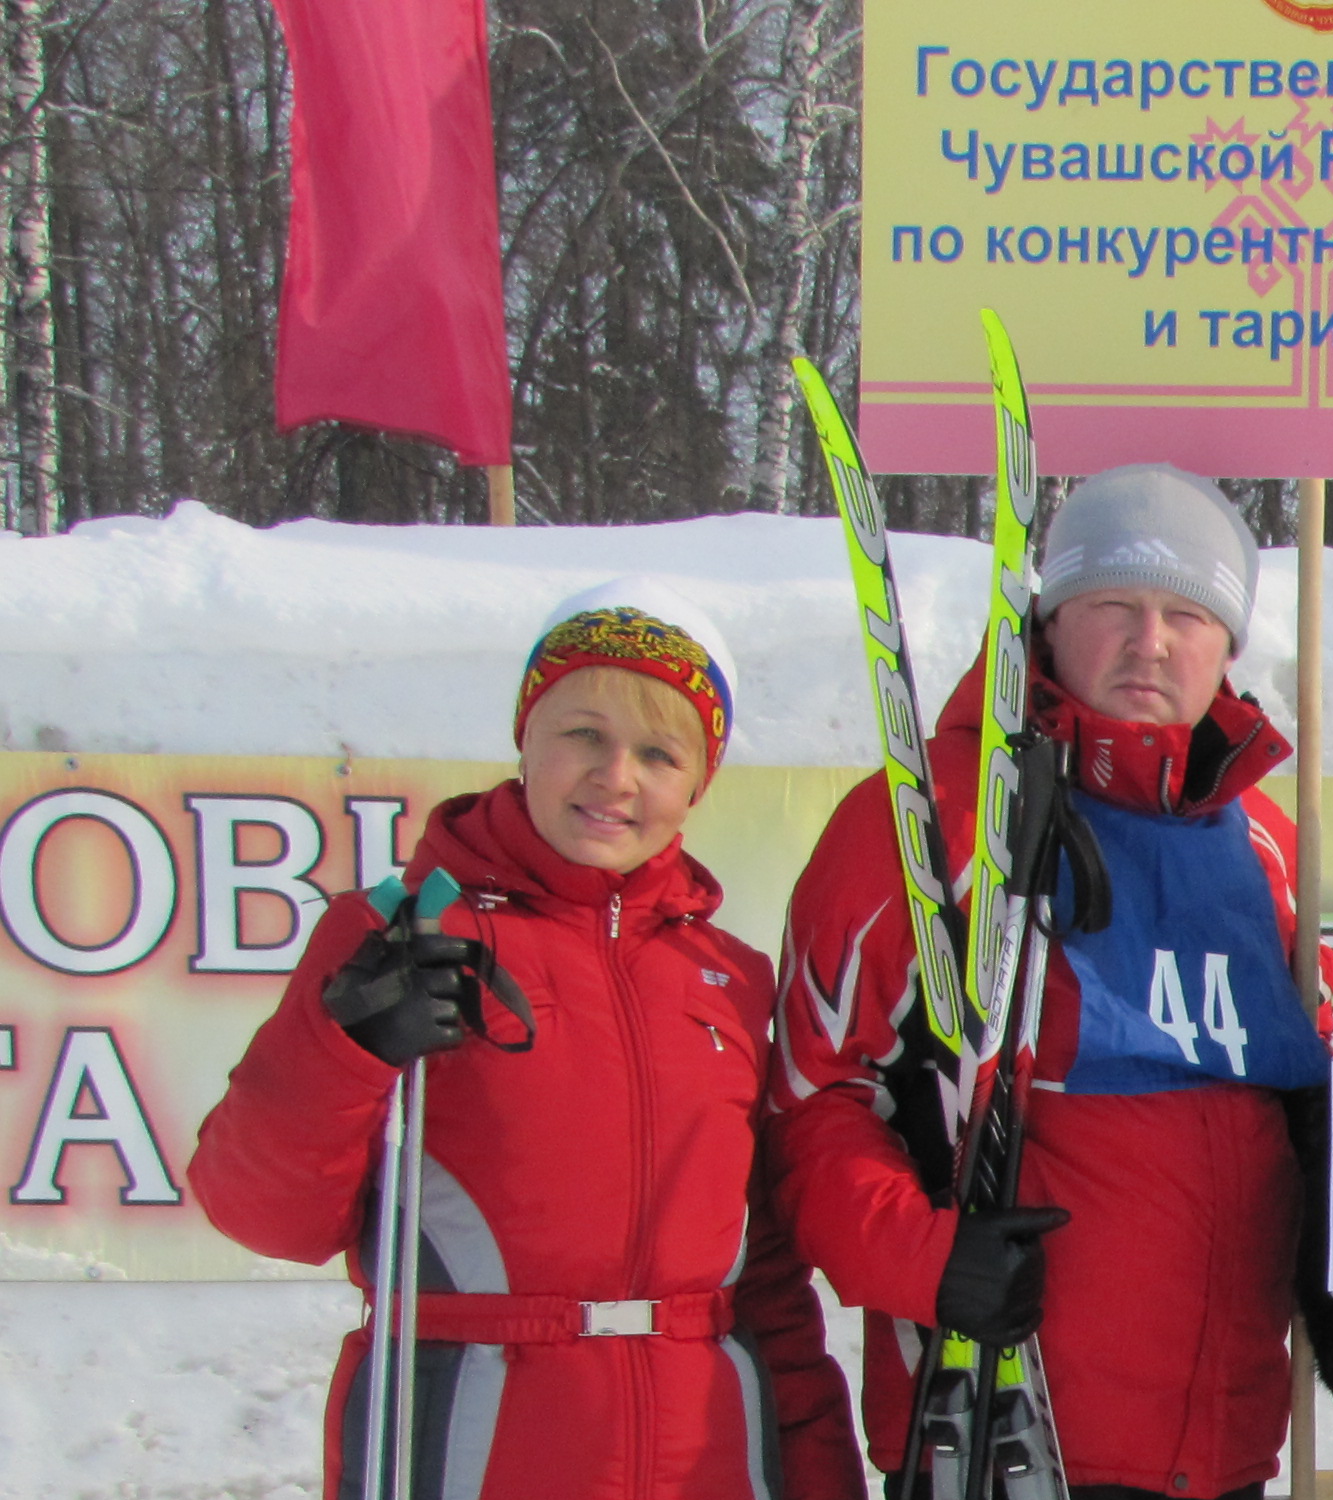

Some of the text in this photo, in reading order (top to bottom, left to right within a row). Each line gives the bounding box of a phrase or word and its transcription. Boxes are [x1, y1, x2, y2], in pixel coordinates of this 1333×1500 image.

[941, 128, 1296, 193] Чувашской
[889, 221, 966, 264] по
[1143, 310, 1179, 348] и
[1150, 949, 1248, 1076] 44
[0, 1022, 183, 1206] А
